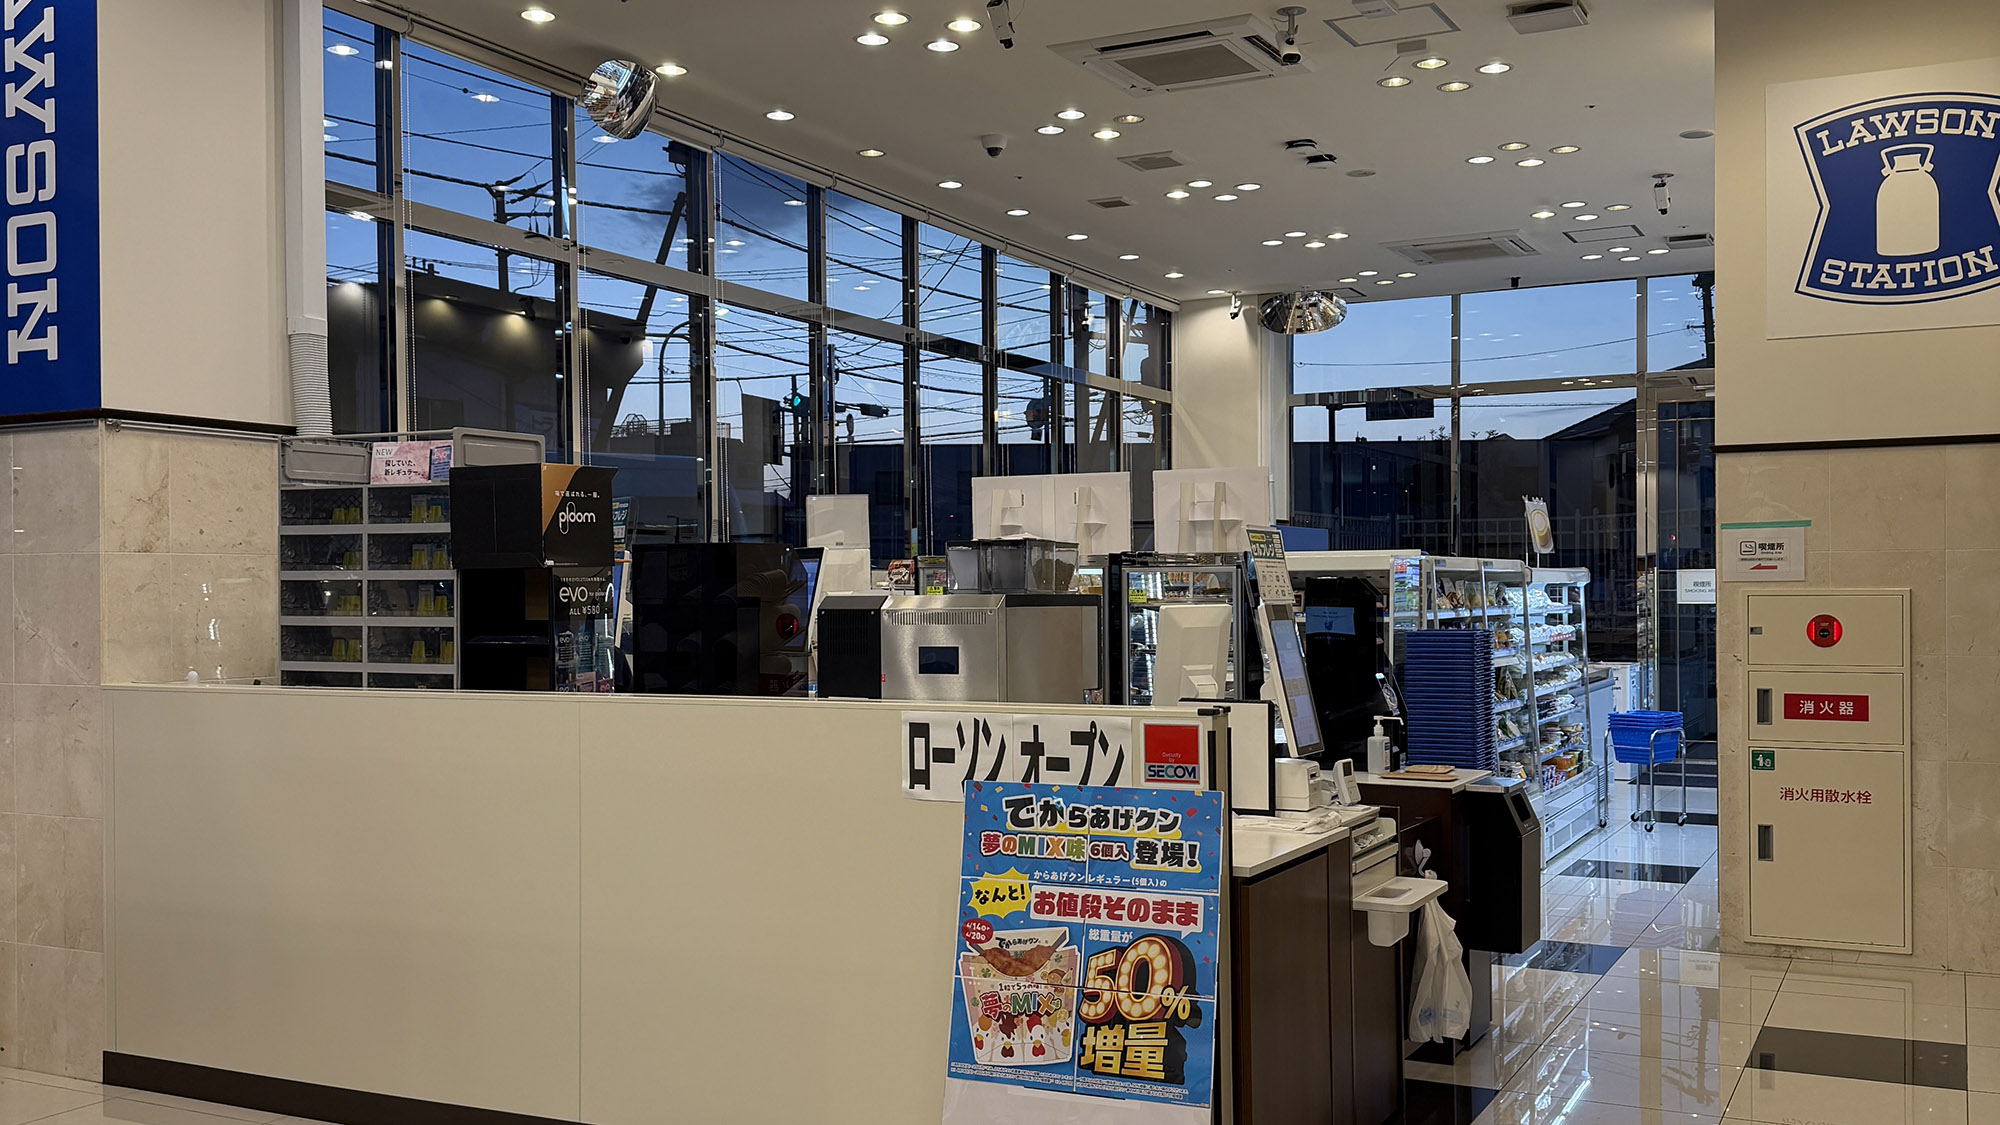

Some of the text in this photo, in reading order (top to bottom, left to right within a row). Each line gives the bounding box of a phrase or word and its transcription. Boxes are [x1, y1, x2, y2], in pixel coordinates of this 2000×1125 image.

[1816, 108, 2000, 157] LAWSON
[4, 0, 58, 364] WSON
[1819, 245, 2000, 290] STATION
[375, 448, 393, 456] NEW
[558, 501, 596, 535] ploom
[1758, 542, 1784, 551] 喫煙所
[559, 586, 588, 602] evo
[569, 605, 600, 615] ALL ¥580
[1799, 700, 1854, 715] 消火器
[908, 717, 1124, 794] ローソン オープン
[1147, 765, 1196, 779] SECOM
[1779, 786, 1872, 805] 消火用散水栓
[1003, 796, 1181, 834] でからあげクン
[981, 832, 1200, 868] 夢のMIX味 6個入 登場!
[974, 883, 1026, 905] なんと!
[1032, 891, 1199, 927] お値段そのまま
[1088, 928, 1133, 943] 総重量が
[1079, 936, 1191, 1022] 50%
[1080, 1021, 1169, 1079] 増量
